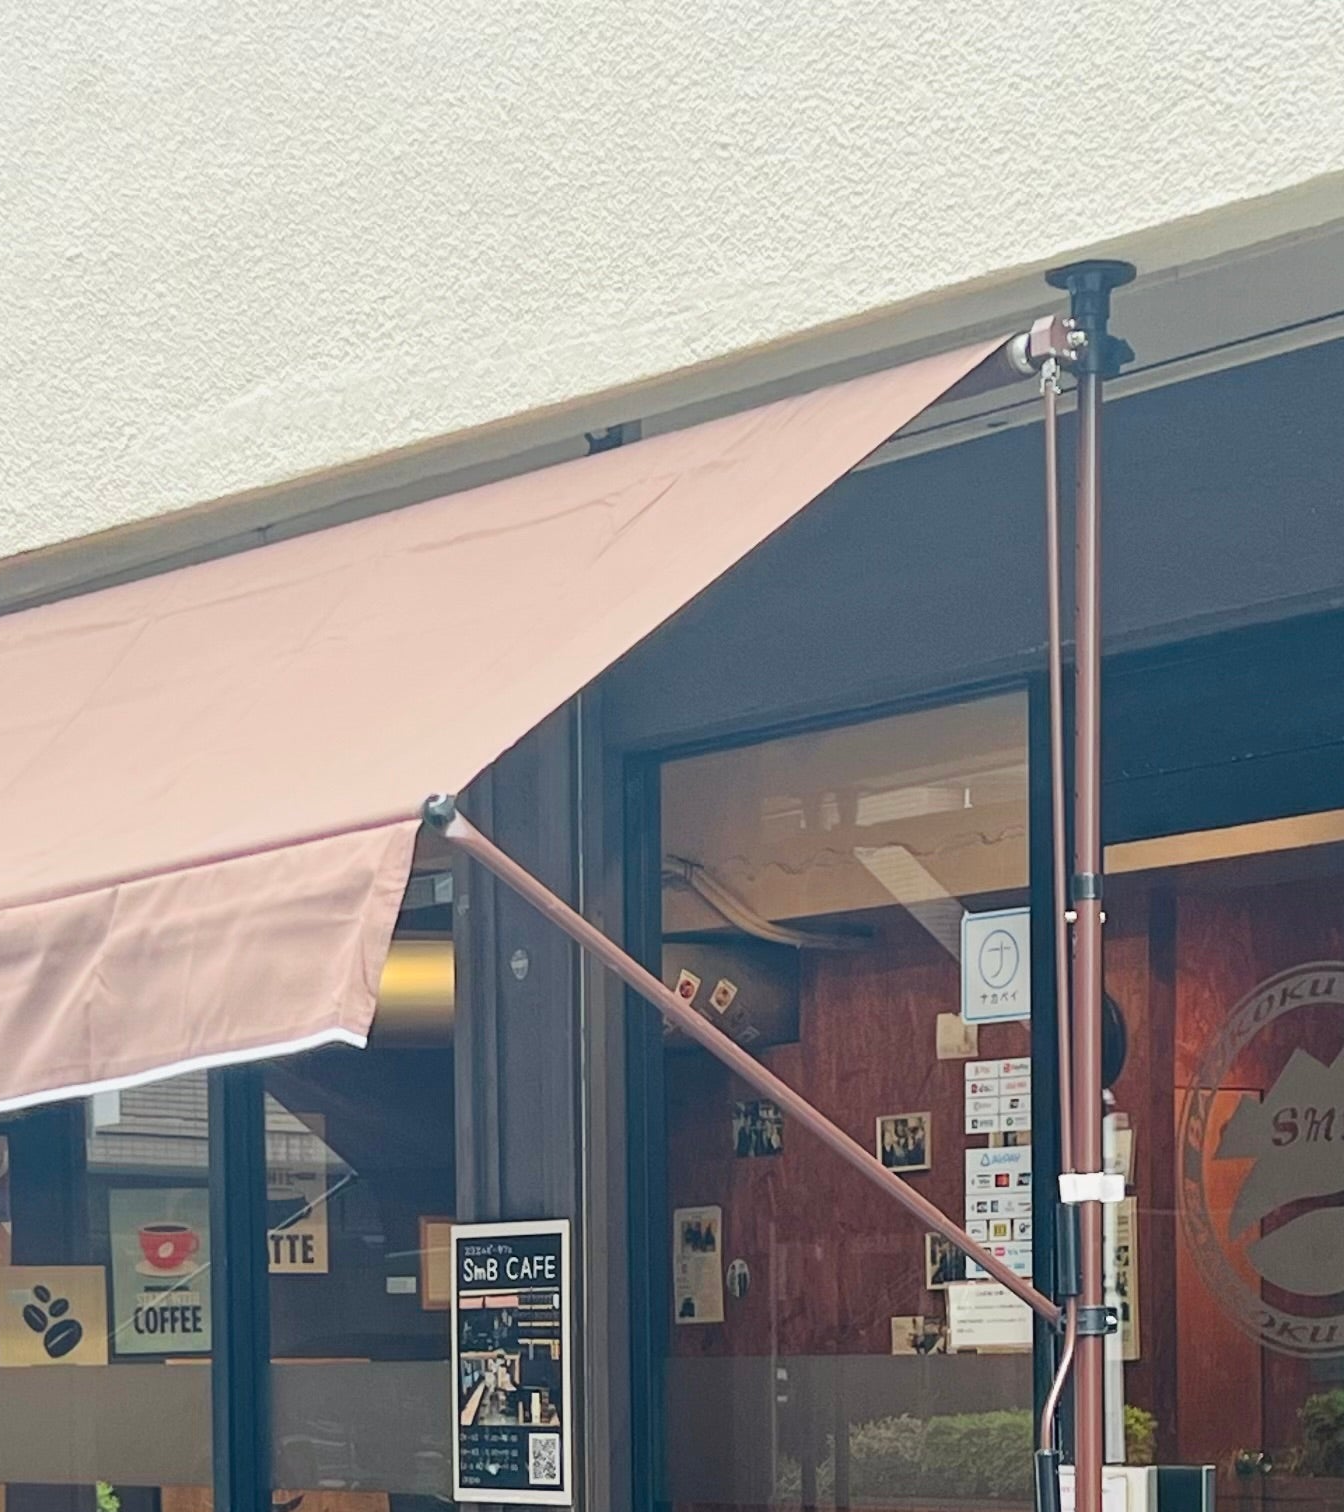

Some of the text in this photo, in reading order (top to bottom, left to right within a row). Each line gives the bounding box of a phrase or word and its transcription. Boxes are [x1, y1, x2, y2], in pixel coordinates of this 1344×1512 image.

[270, 1234, 315, 1264] TTE
[463, 1255, 556, 1282] SmB CAFE
[134, 1306, 202, 1334] COFFEE
